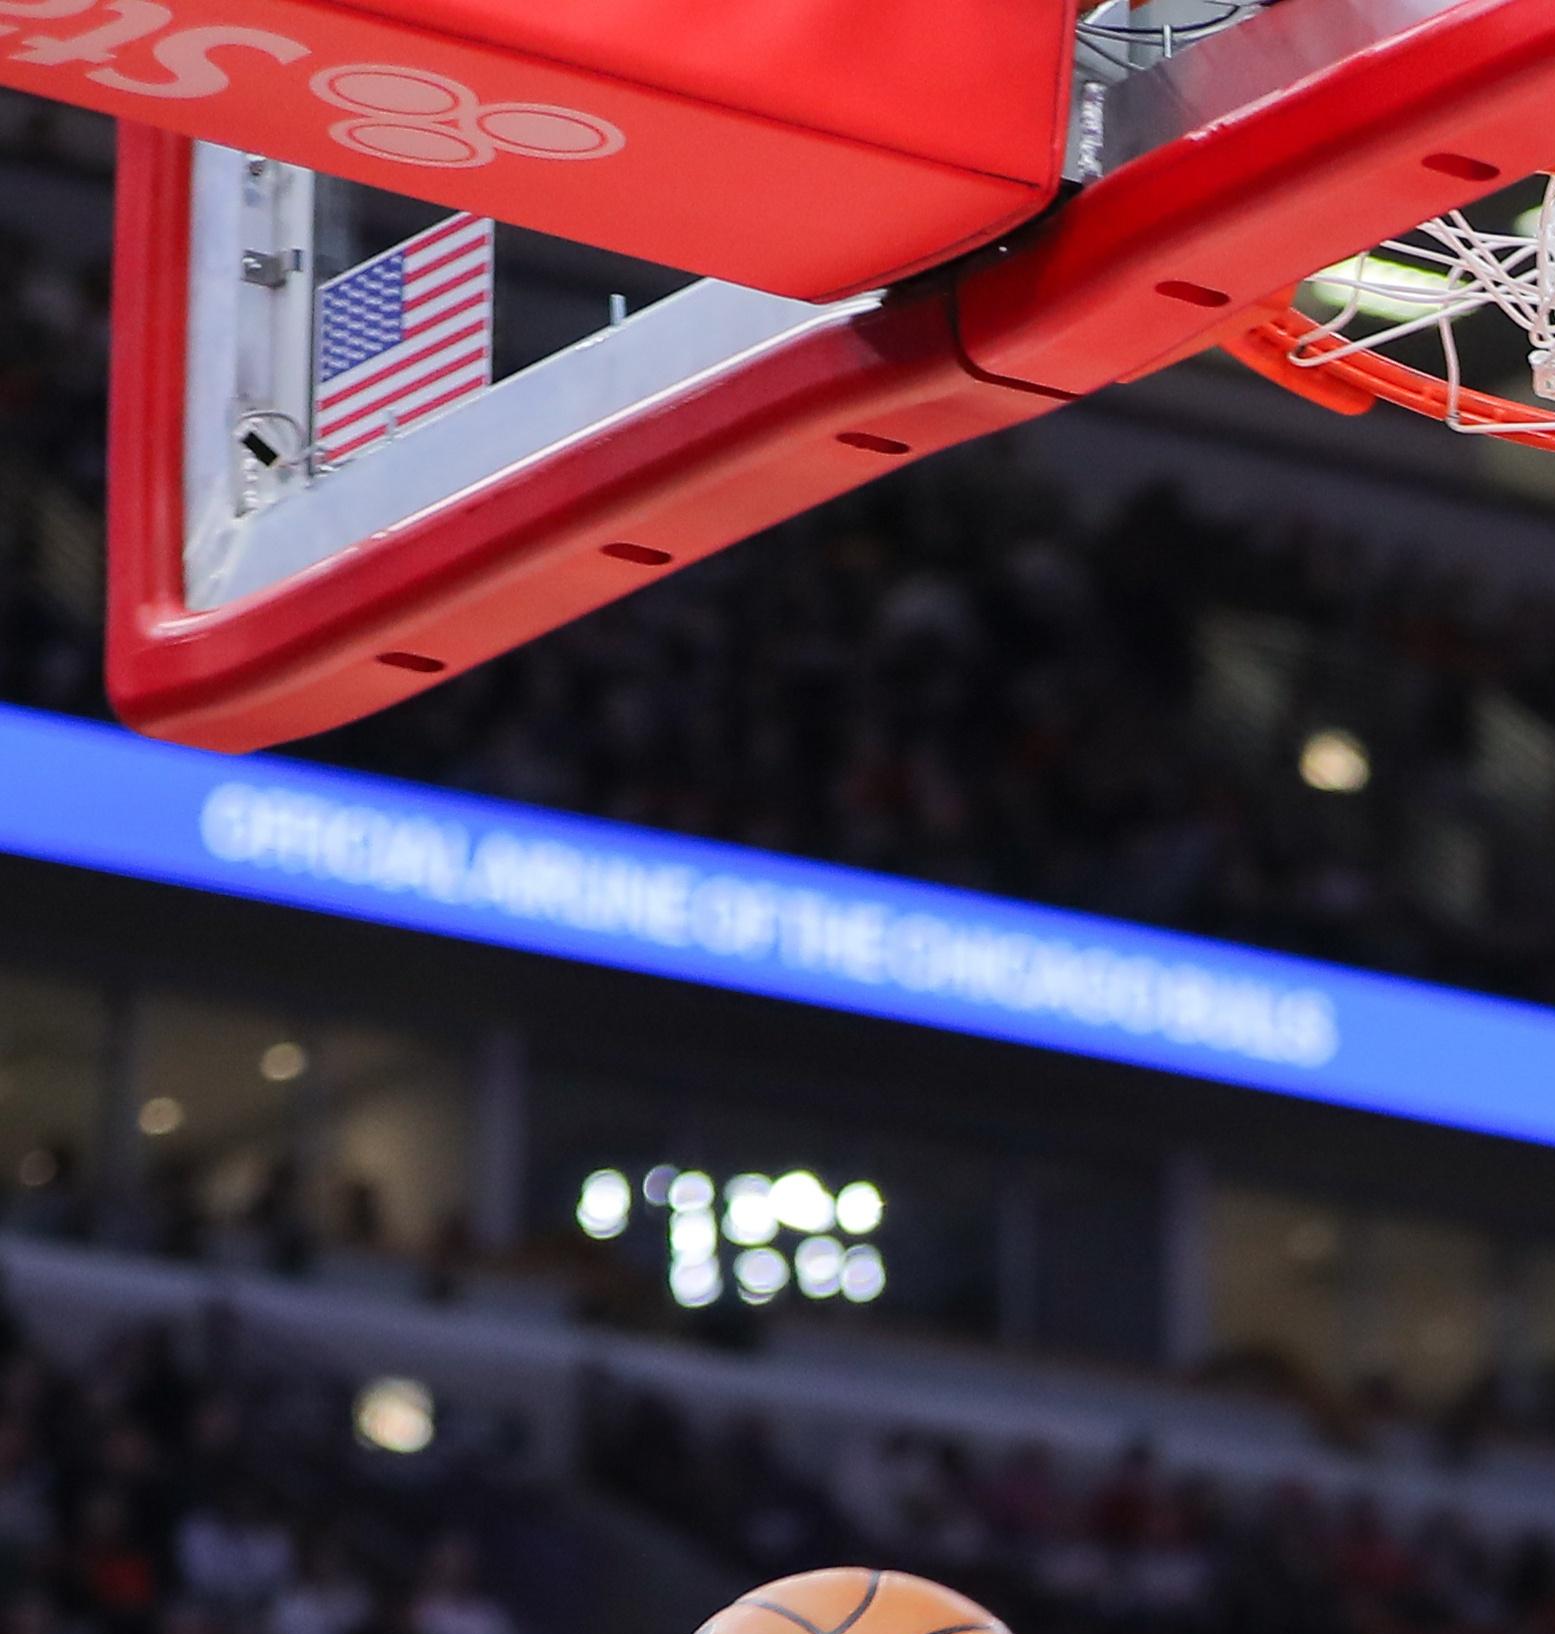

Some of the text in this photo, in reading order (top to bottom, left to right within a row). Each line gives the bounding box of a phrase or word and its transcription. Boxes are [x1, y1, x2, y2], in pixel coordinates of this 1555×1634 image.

[201, 783, 1339, 1068] OFFICIAL AIRLINE OF THE CHICAGO BULLS
